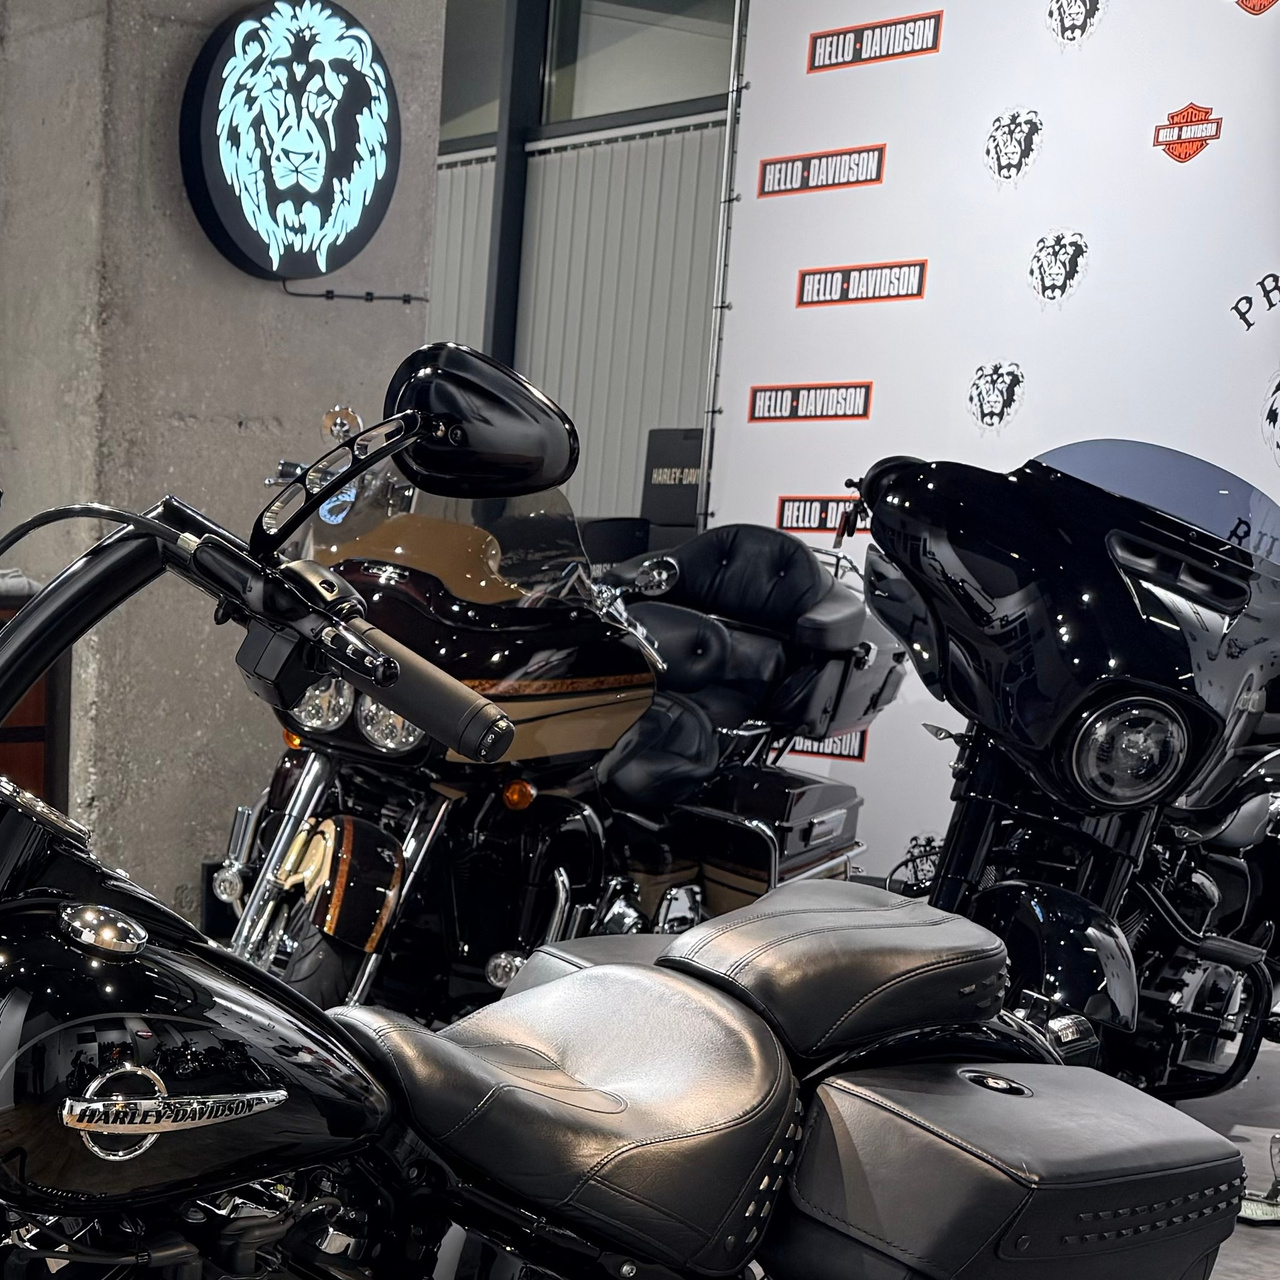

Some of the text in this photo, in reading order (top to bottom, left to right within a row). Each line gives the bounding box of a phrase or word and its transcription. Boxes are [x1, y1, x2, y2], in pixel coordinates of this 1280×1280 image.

[814, 18, 935, 67] HELLO DAVIDSON
[1173, 109, 1206, 124] MOTOR
[764, 150, 879, 192] HELLO DAVIDSON
[802, 265, 921, 302] HELLO DAVIDSON
[754, 387, 866, 418] HELLO DAVIDSON
[782, 500, 821, 528] HELLO
[76, 1096, 256, 1125] HARLEY-DAVIDSON
